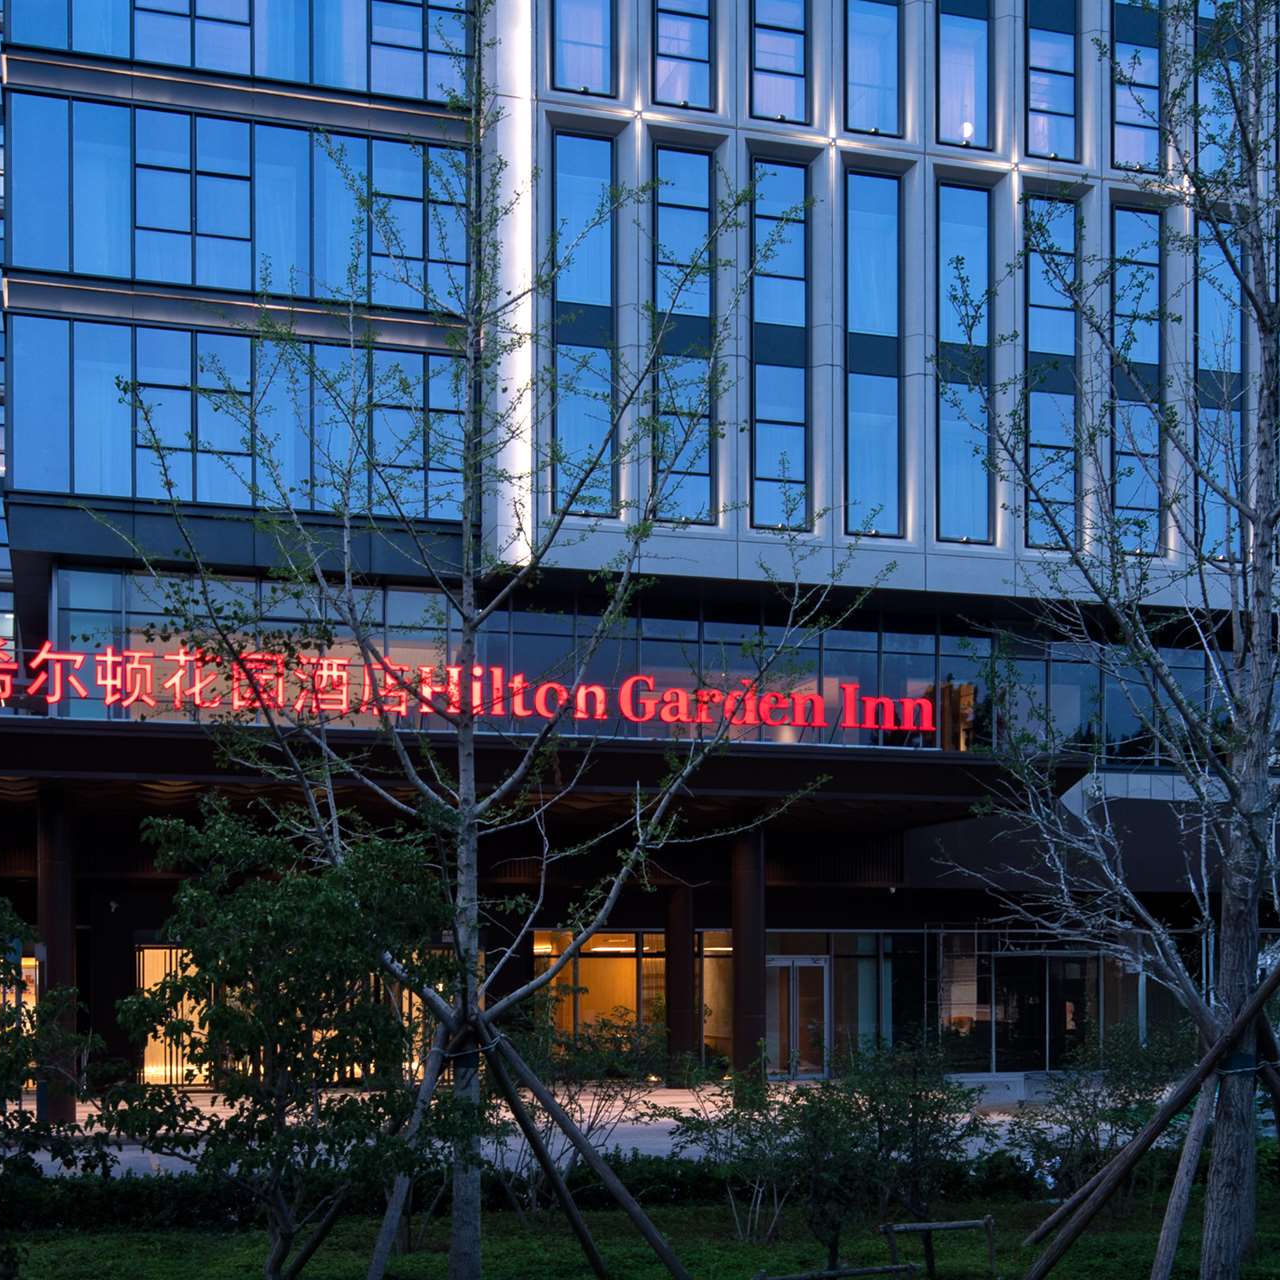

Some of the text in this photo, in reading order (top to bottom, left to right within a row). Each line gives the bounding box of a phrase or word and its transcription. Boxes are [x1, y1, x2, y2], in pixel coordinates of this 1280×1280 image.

[418, 664, 609, 720] Hilton
[619, 674, 828, 728] Garden
[839, 682, 937, 732] Inn
